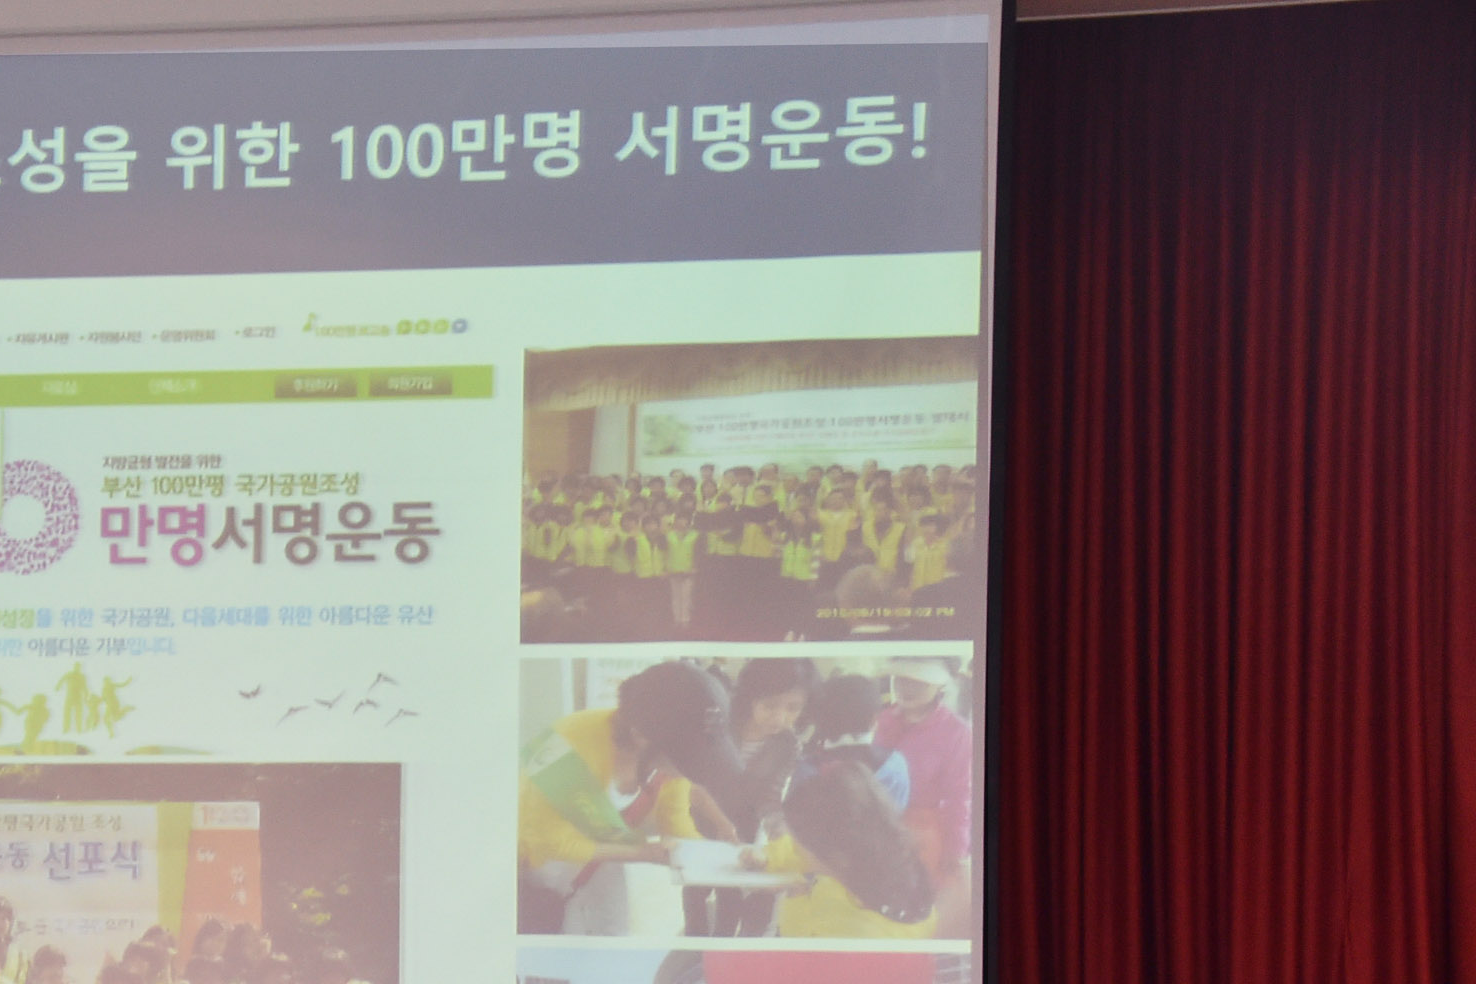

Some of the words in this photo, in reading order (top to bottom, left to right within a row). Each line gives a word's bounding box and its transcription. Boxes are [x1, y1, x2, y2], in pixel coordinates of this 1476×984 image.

[165, 120, 301, 191] 위한
[330, 109, 584, 183] 100만명
[614, 95, 929, 176] 서명운동!
[102, 455, 153, 471] 지방균형
[154, 455, 192, 470] 발전을
[195, 454, 223, 469] 위한
[100, 475, 143, 498] 부산
[151, 473, 226, 498] 100만평
[234, 471, 361, 497] 국가공원조성
[100, 501, 441, 567] 만명서명운동
[60, 607, 95, 628] 위한
[101, 606, 176, 629] 국가공원,
[182, 605, 271, 628] 다음세대를
[278, 605, 313, 627] 위한
[319, 604, 392, 626] 아름다운
[397, 603, 434, 626] 유산
[27, 637, 92, 657] 아름다운
[91, 814, 124, 832] 조성
[42, 839, 143, 882] 선포식
